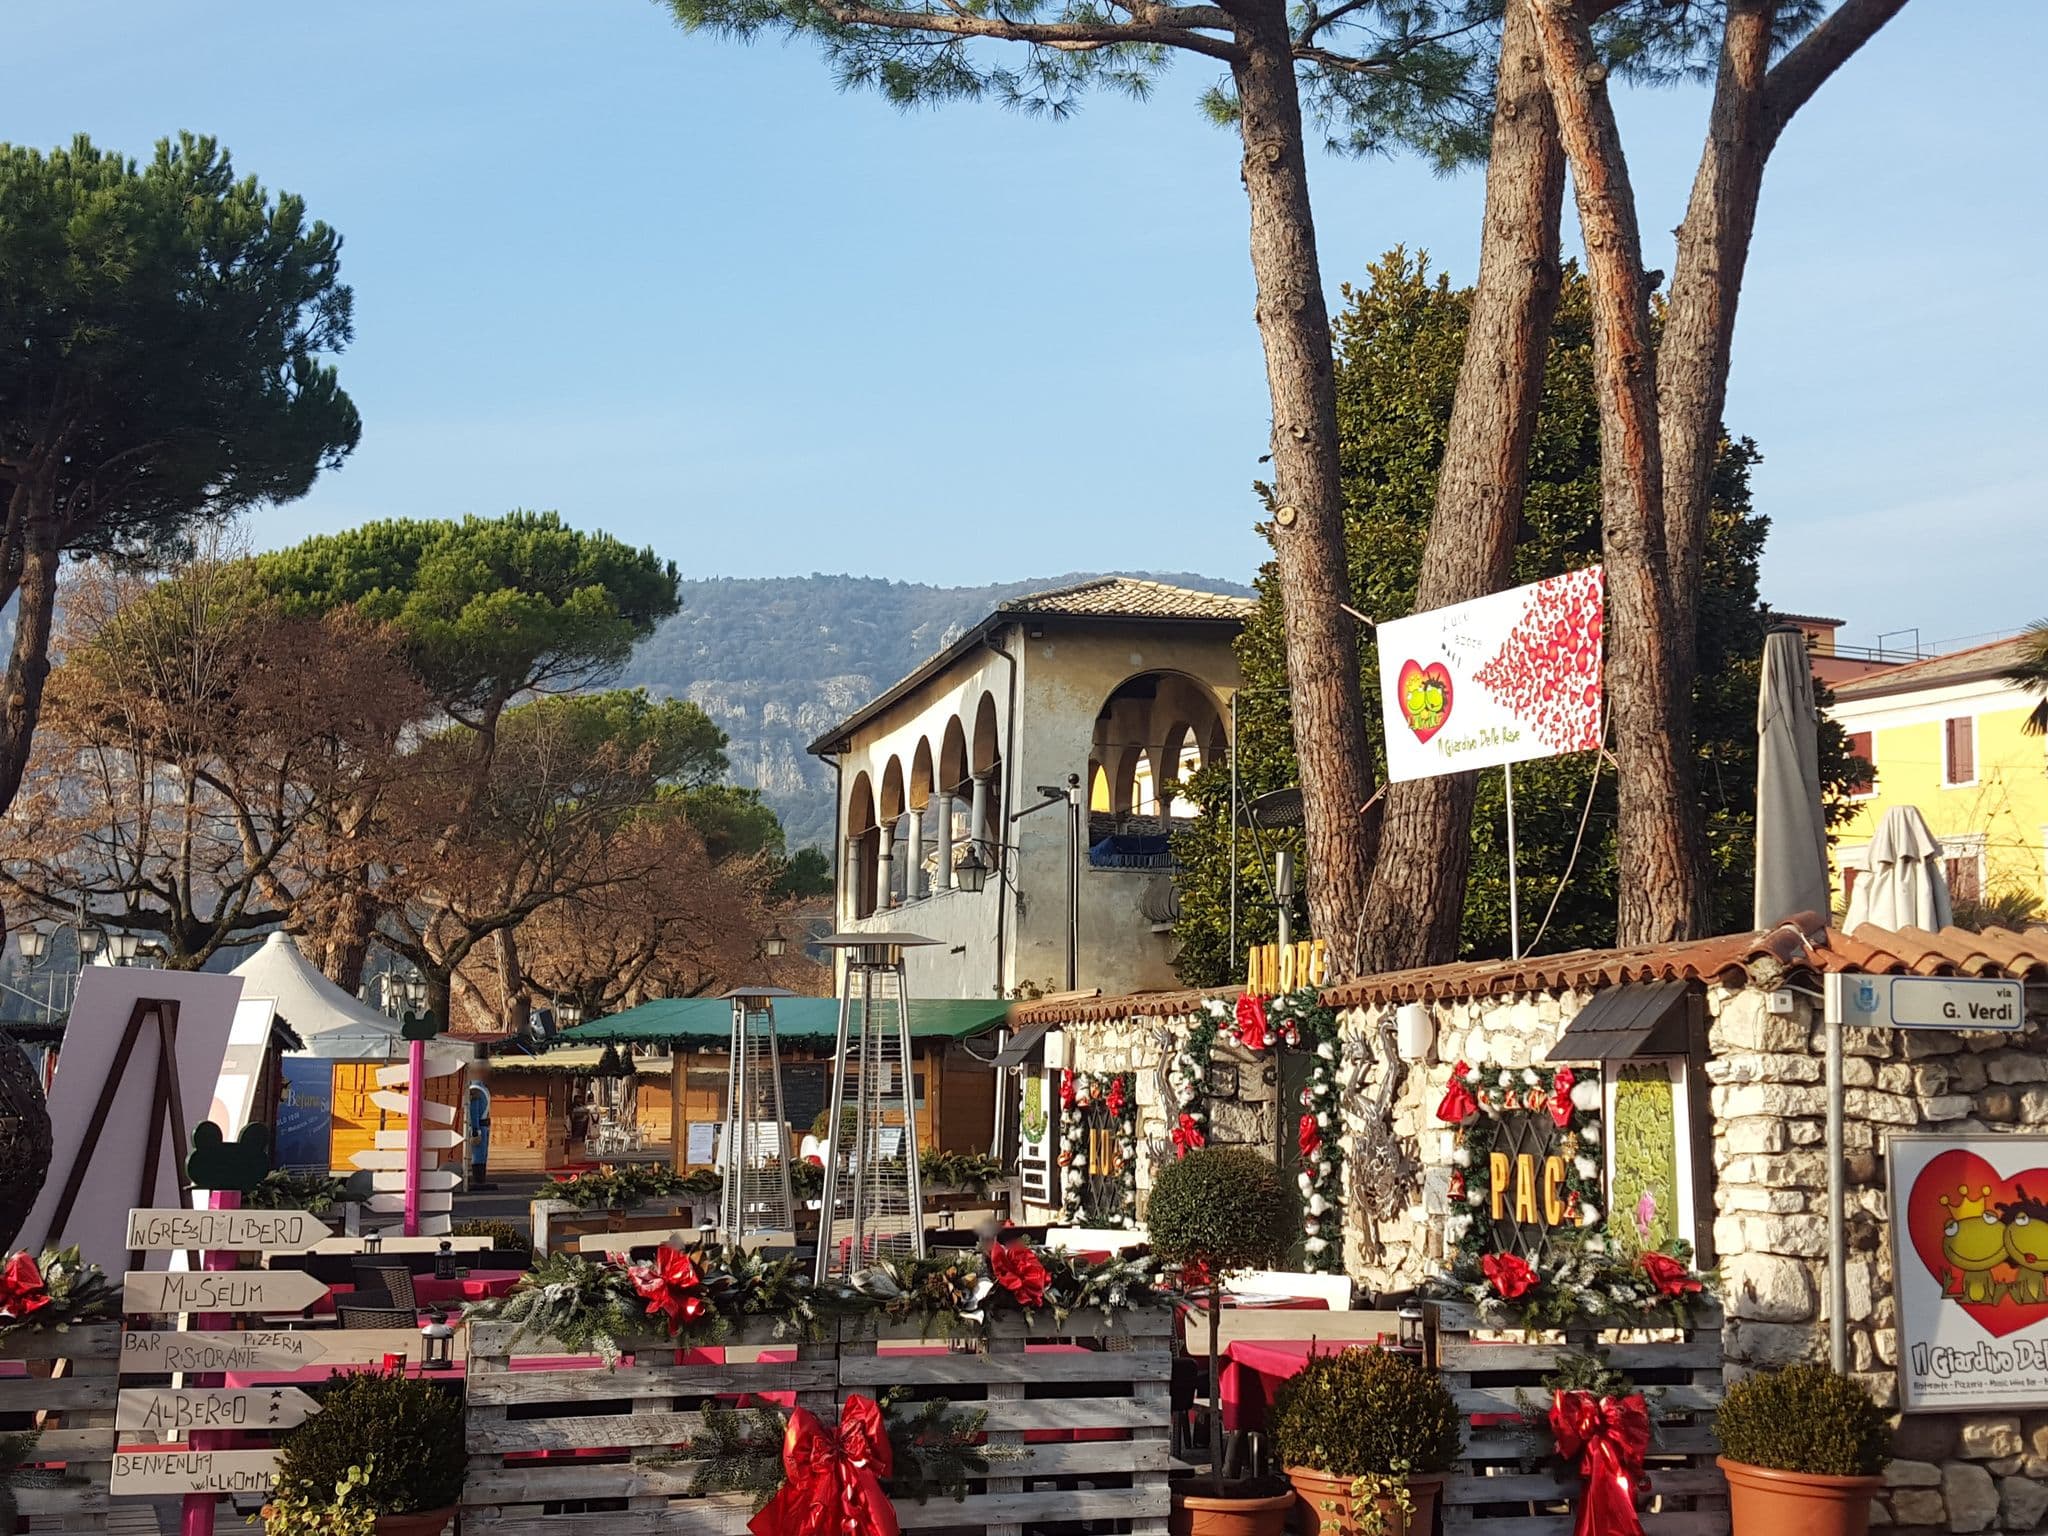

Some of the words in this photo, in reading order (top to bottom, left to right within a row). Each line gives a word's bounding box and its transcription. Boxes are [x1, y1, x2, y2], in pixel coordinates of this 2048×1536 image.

[1247, 939, 1328, 998] AMORE
[1996, 988, 2012, 998] via
[1943, 1001, 1961, 1019] G.
[1968, 1002, 2012, 1020] Verdi
[1490, 1152, 1583, 1227] PAC
[130, 1213, 214, 1246] INGRESSO
[228, 1216, 303, 1244] LIBERO
[160, 1276, 263, 1310] MUSEUM
[125, 1333, 161, 1351] BAR
[164, 1346, 261, 1369] RISTORANTE
[1930, 1341, 2013, 1378] Giardino
[143, 1395, 246, 1428] ALBERGO
[115, 1454, 213, 1477] BENVENUTI
[190, 1471, 281, 1490] WILLKOMME
